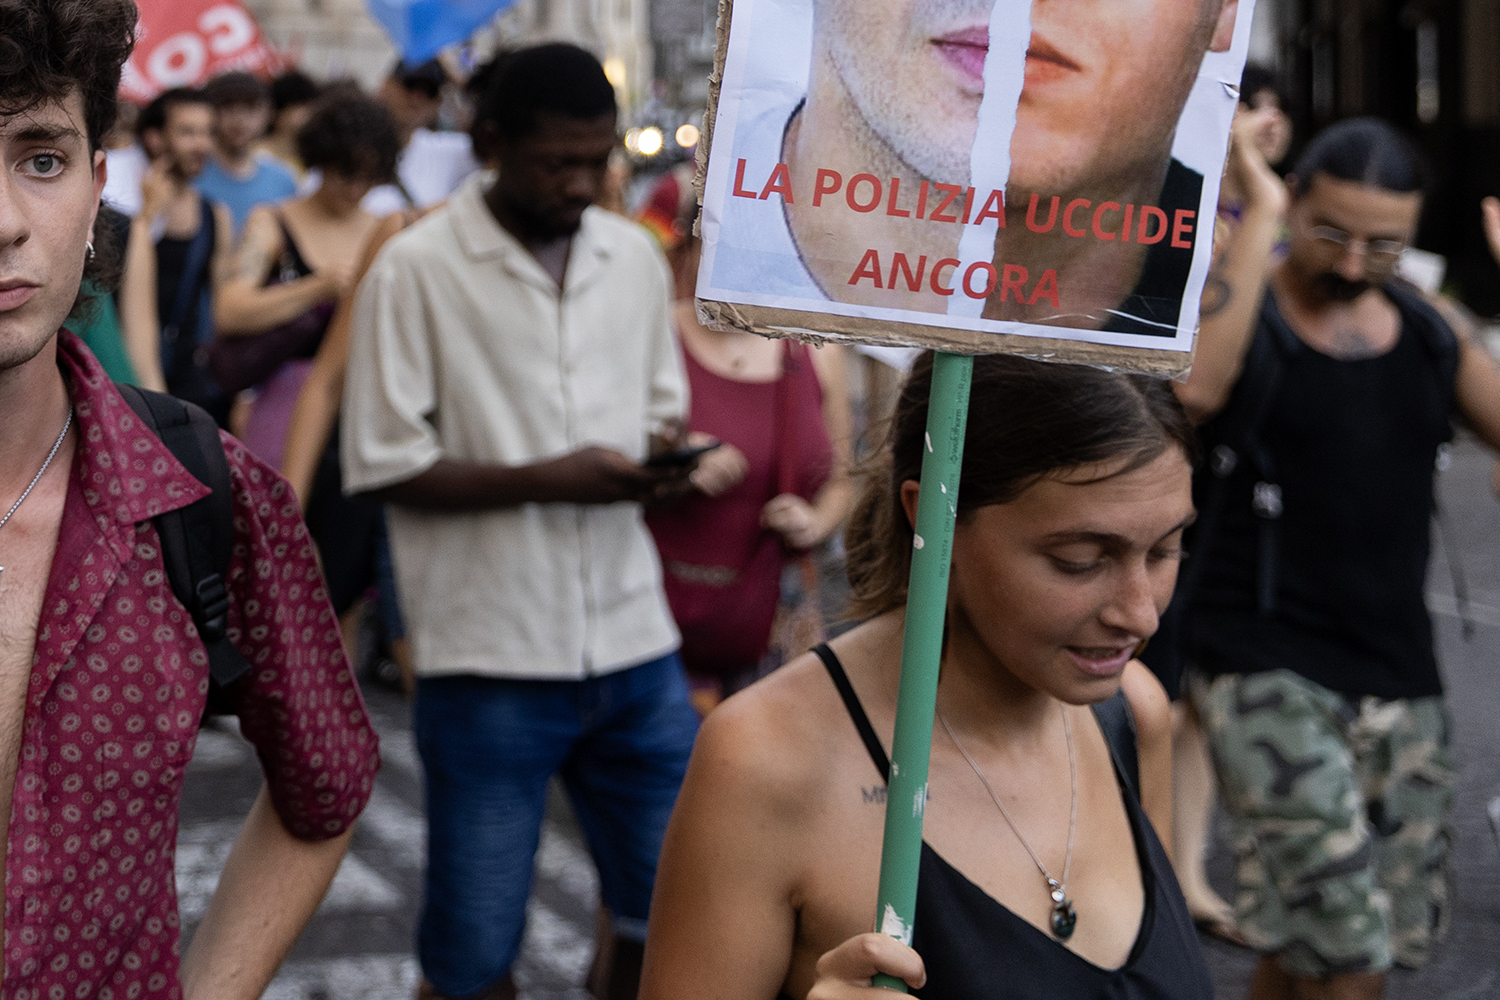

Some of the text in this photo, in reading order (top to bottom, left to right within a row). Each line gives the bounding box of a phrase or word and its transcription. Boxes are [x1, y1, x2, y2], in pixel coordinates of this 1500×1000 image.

[732, 158, 1196, 249] LA POLIZIA UCCIDE
[848, 248, 1061, 308] ANCORA
